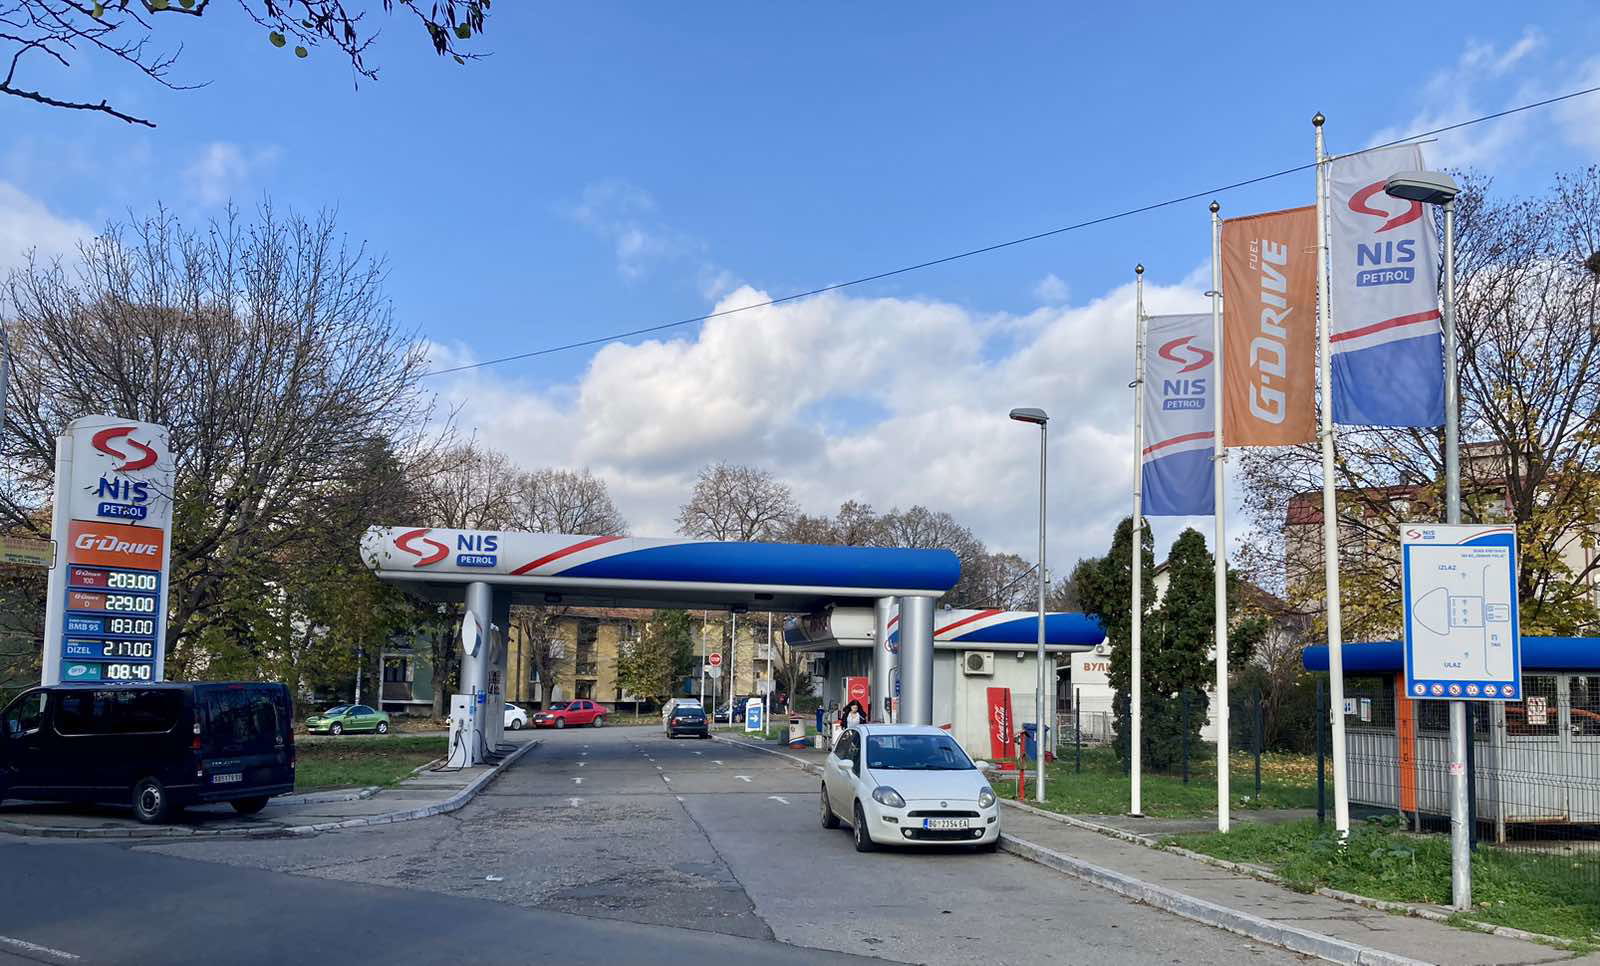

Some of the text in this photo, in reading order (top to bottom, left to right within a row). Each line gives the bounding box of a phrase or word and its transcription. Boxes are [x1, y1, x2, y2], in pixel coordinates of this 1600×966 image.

[1250, 238, 1258, 271] FUEL
[1357, 239, 1416, 266] NIS
[1362, 270, 1410, 284] PETROL
[1163, 378, 1206, 396] NIS
[1167, 400, 1201, 409] PETROL
[98, 477, 148, 502] NIS
[103, 504, 144, 517] PETROL
[457, 534, 497, 551] NIS
[461, 555, 491, 564] PETROL
[107, 572, 157, 590] 203.00
[105, 595, 155, 612] 229.00
[68, 623, 88, 631] BMB
[111, 618, 153, 635] 183.00
[66, 646, 92, 654] DIZEL
[107, 664, 151, 680] 108.40
